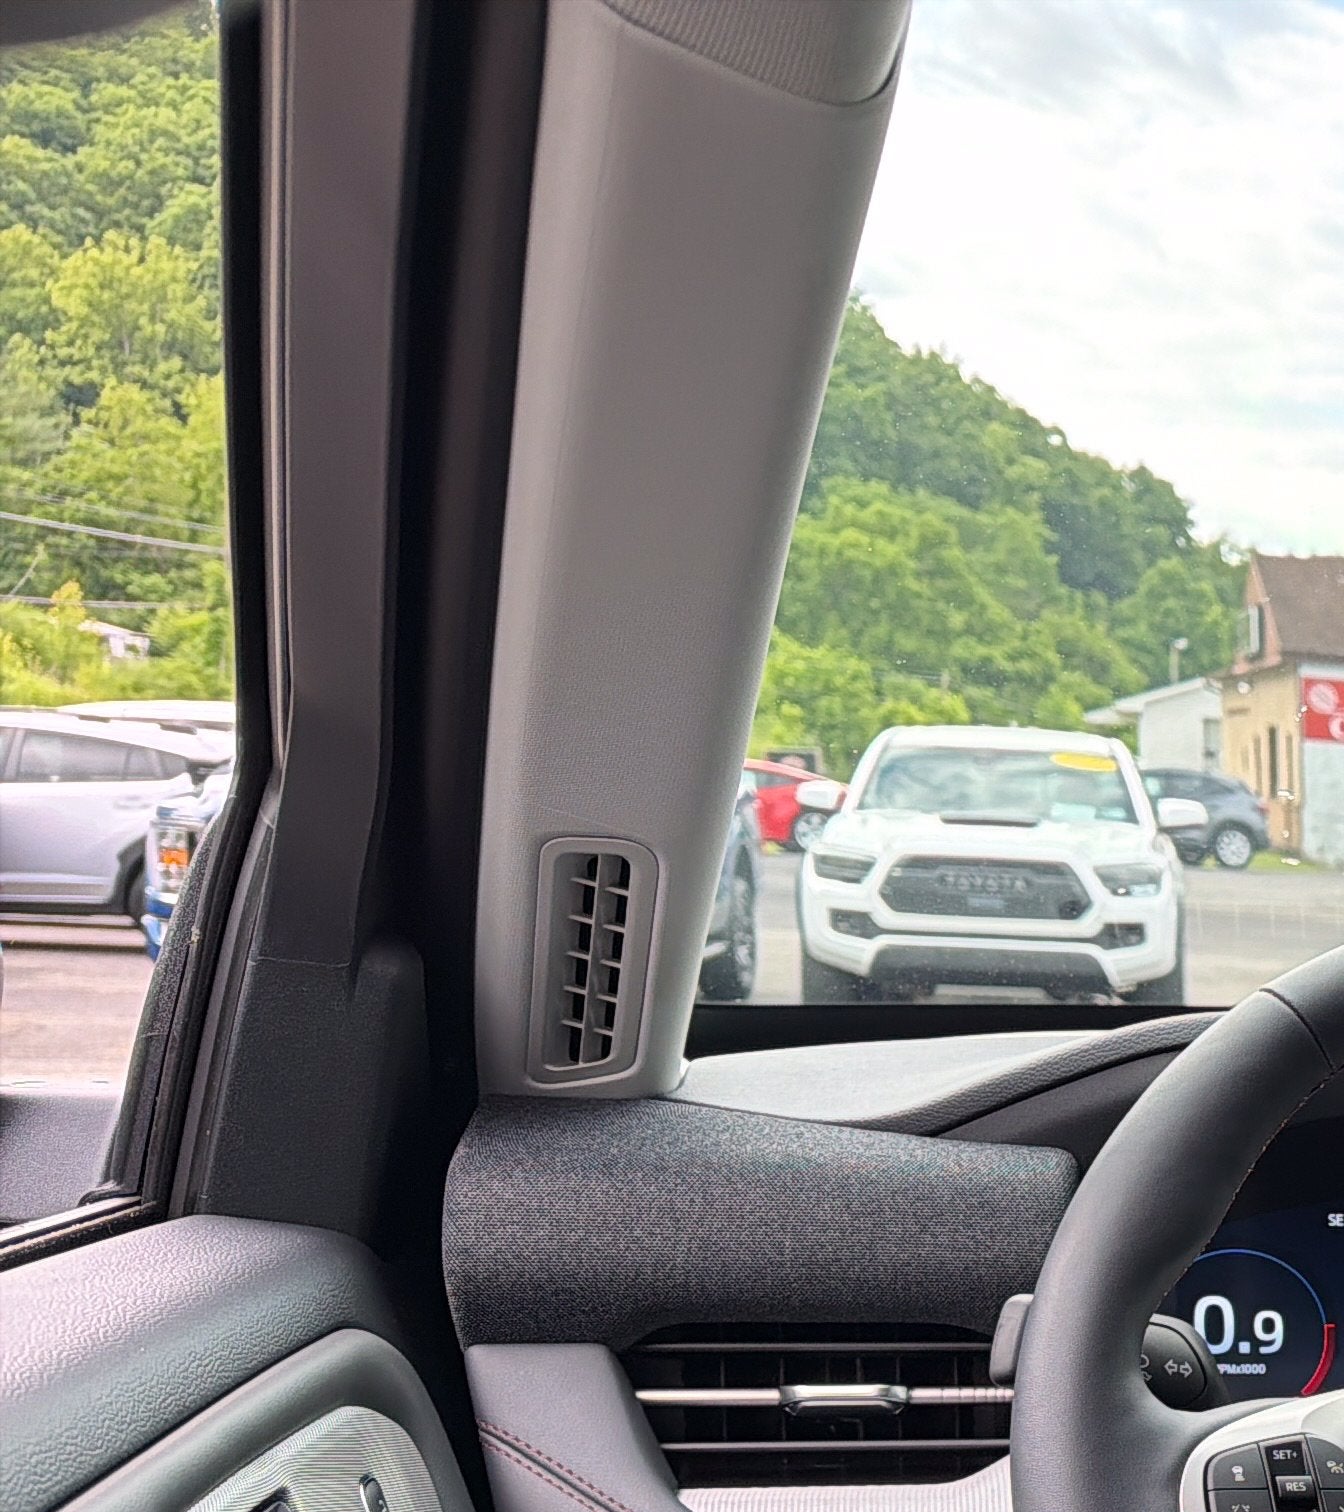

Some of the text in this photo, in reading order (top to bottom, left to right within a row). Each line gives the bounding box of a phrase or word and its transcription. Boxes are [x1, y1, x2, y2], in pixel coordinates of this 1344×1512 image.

[1327, 1213, 1344, 1227] SE
[1193, 1295, 1284, 1355] 0.9
[1273, 1450, 1298, 1460] SET+
[1286, 1482, 1307, 1492] RES
